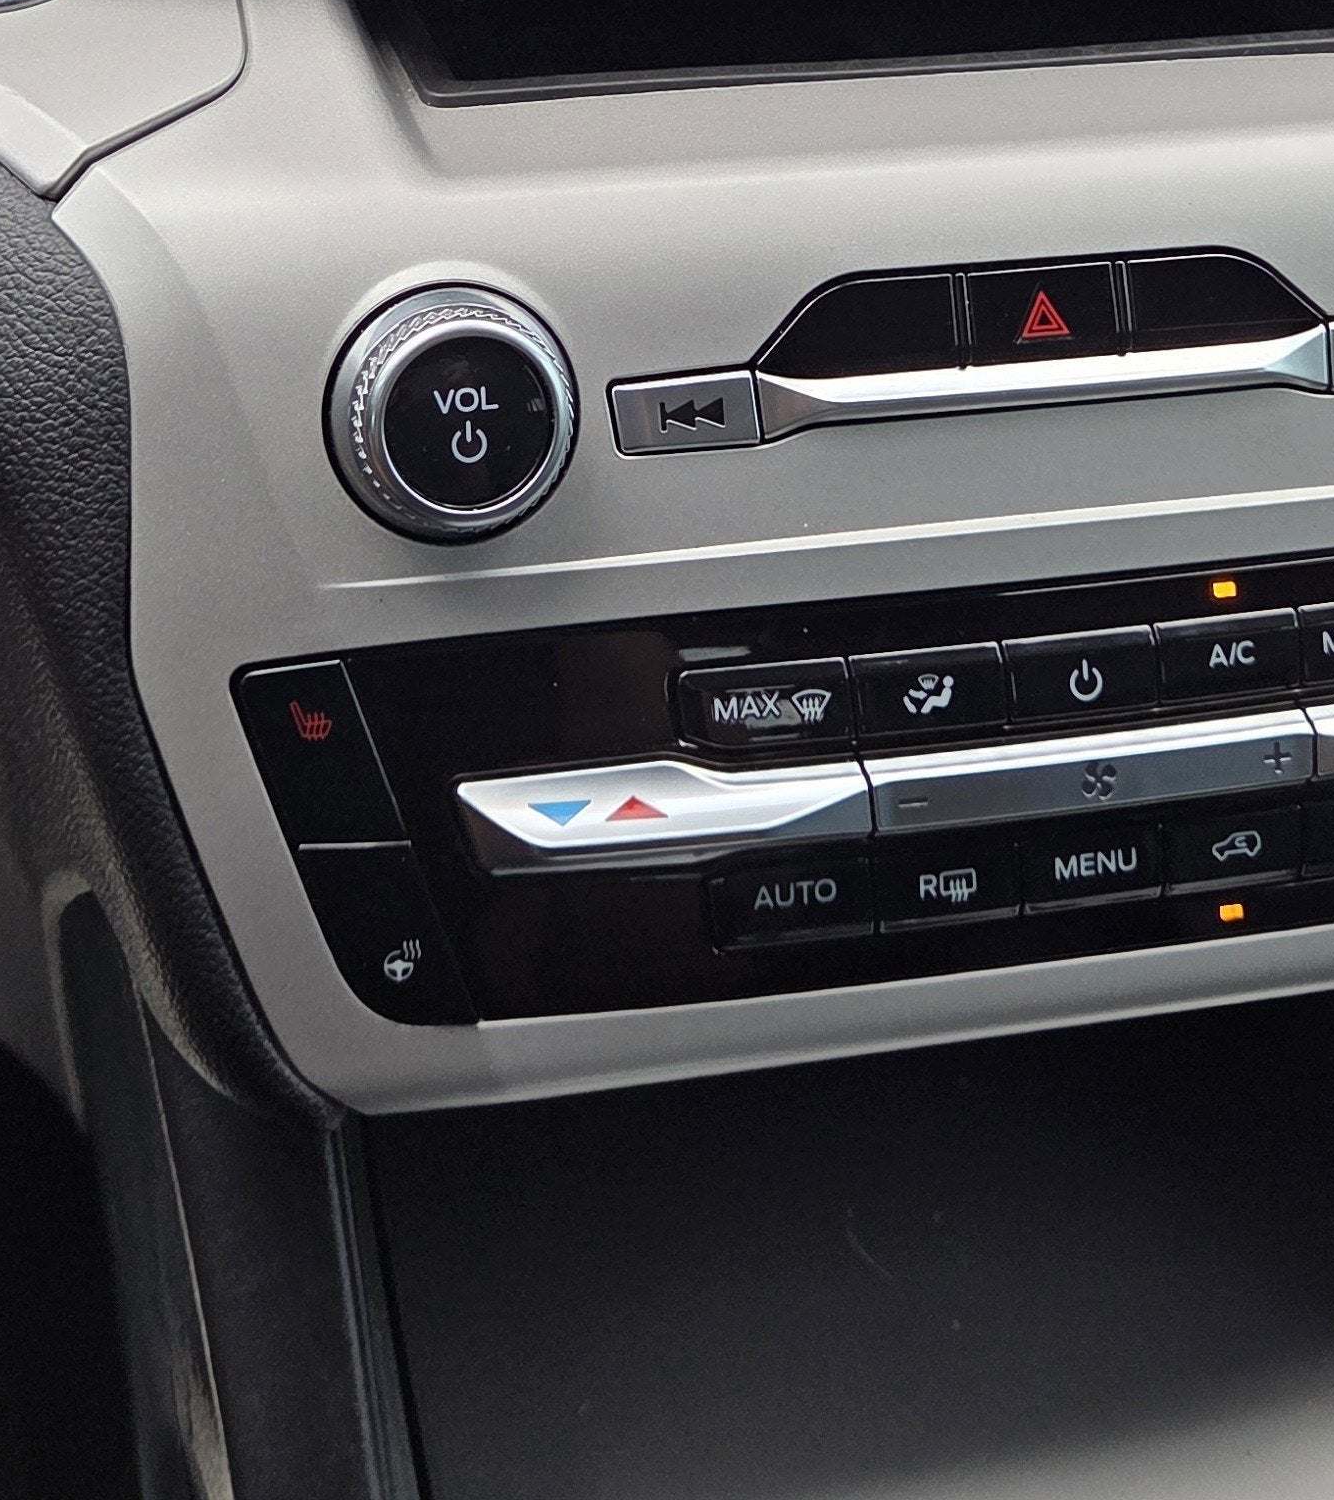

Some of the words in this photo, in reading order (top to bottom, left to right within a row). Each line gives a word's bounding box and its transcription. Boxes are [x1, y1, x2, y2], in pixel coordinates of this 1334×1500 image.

[433, 385, 499, 415] VOL
[1208, 639, 1256, 669] A/C
[712, 690, 781, 723] MAX
[1053, 846, 1138, 881] MENU
[753, 877, 838, 912] AUTO
